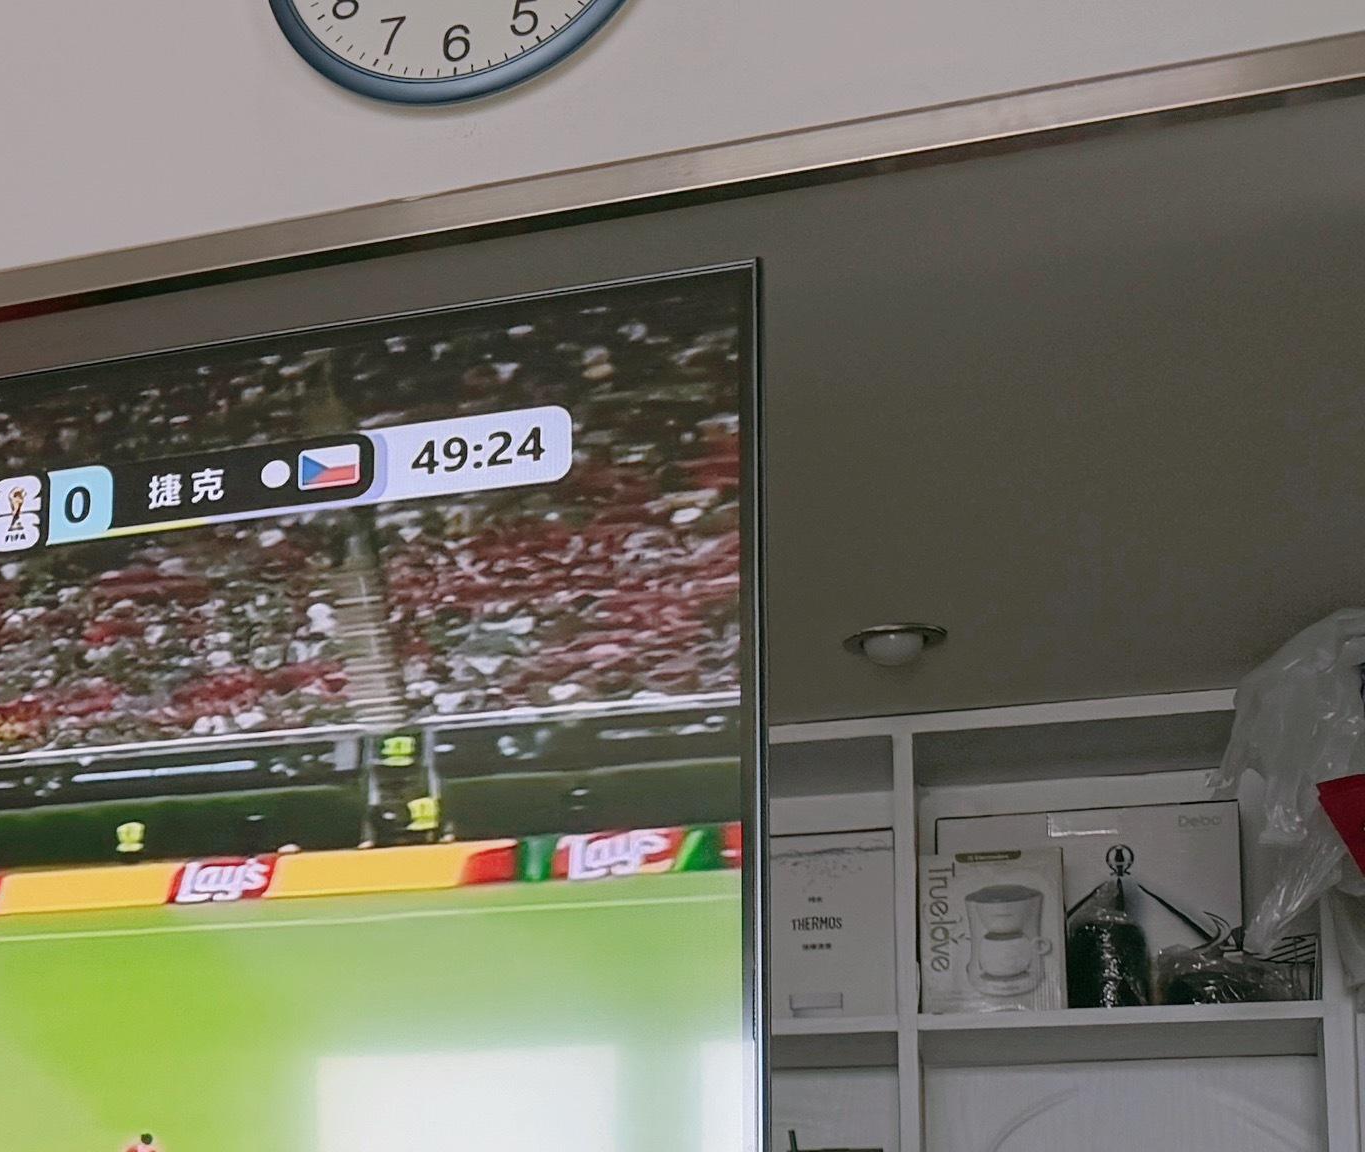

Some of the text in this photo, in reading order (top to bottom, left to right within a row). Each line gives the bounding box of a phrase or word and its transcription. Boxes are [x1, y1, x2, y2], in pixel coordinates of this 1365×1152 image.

[380, 16, 407, 56] 7
[442, 24, 471, 62] 6
[410, 425, 547, 475] 49:24
[63, 485, 92, 524] 0
[148, 467, 226, 509] 捷克
[4, 532, 27, 543] FIFA
[177, 859, 270, 904] Lay's
[791, 916, 843, 931] THERMOS
